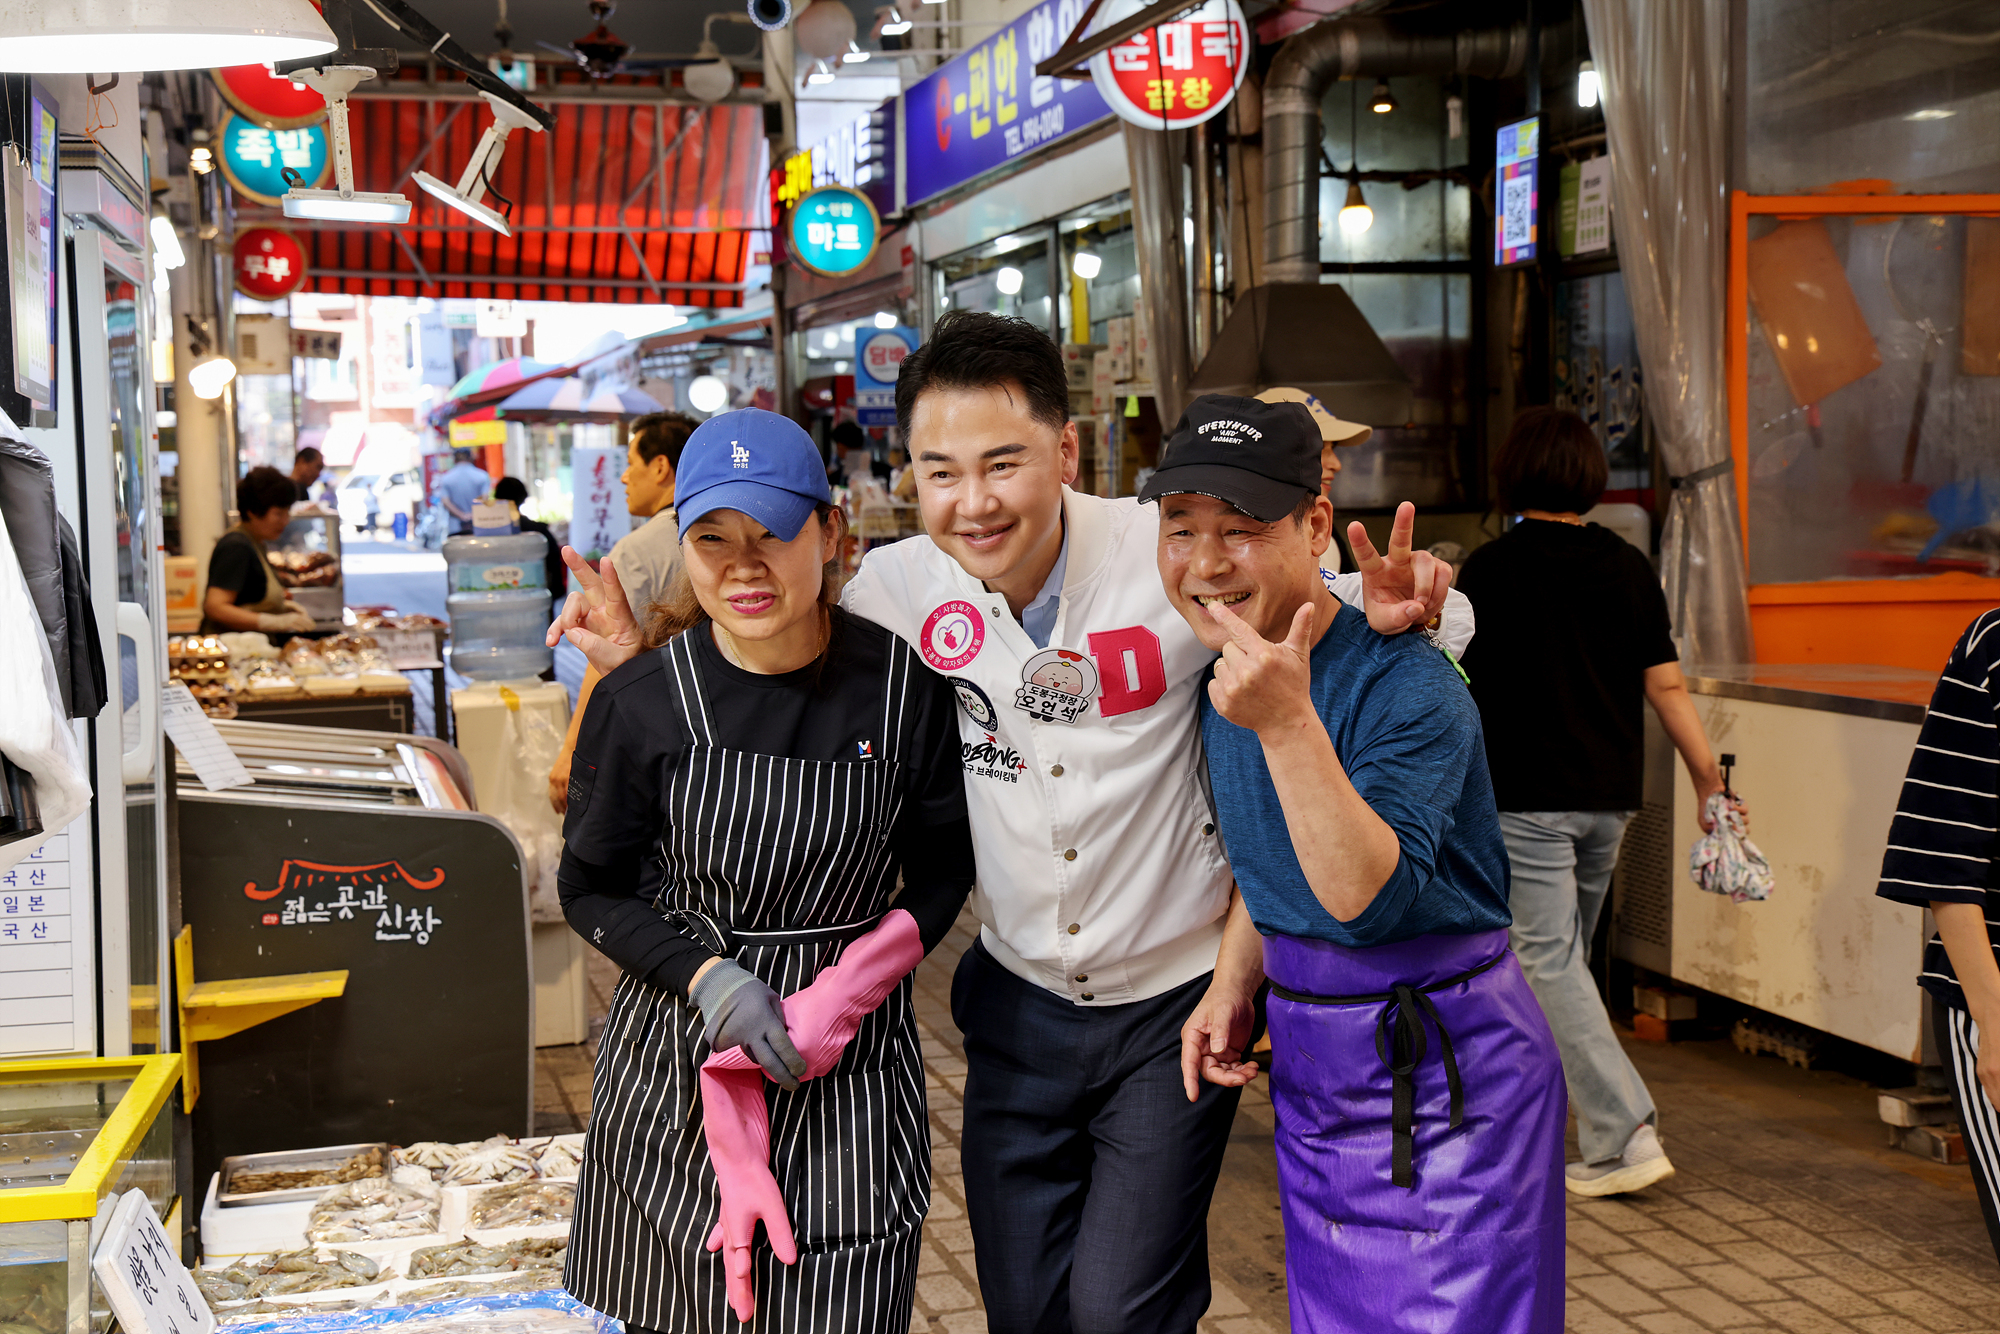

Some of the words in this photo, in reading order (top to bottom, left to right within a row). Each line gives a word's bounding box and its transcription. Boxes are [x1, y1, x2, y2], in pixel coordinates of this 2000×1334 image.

[1145, 77, 1213, 111] 곱창
[236, 128, 315, 168] 족발
[807, 222, 862, 252] 마트
[243, 255, 291, 283] 두부
[1197, 420, 1263, 442] EVERYHOUR
[1211, 436, 1243, 444] MOMENT
[730, 440, 750, 463] LA
[1087, 625, 1167, 718] D
[1029, 686, 1078, 705] 도봉구청장
[961, 743, 1020, 770] OBONG
[976, 766, 1018, 783] 브레이킹팀
[375, 903, 442, 945] 신창
